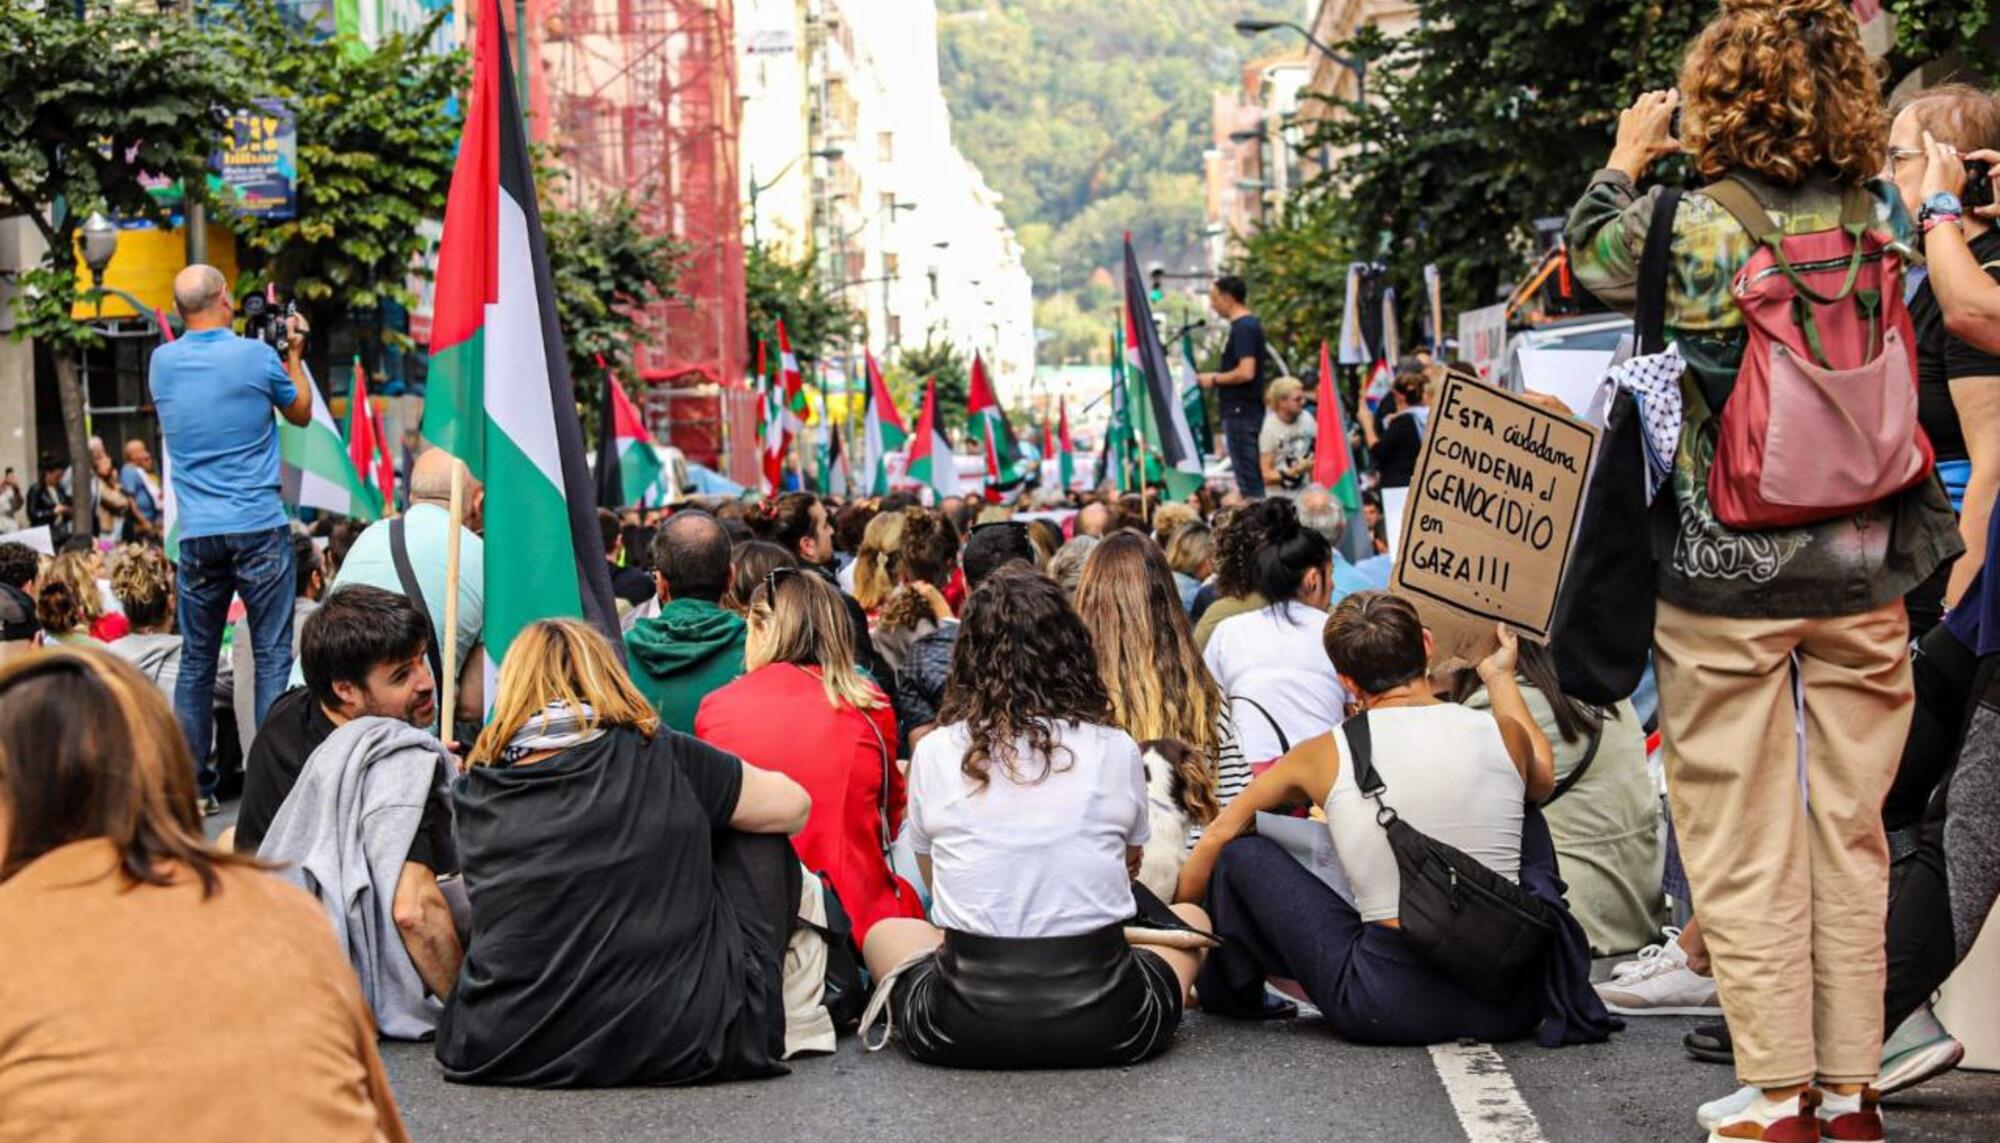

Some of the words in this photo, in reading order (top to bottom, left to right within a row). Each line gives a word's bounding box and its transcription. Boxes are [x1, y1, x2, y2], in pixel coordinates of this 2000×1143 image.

[1434, 436, 1534, 494] CONDENA
[1539, 476, 1557, 502] el
[1420, 515, 1443, 535] en
[1411, 541, 1510, 610] GAZA!!!
